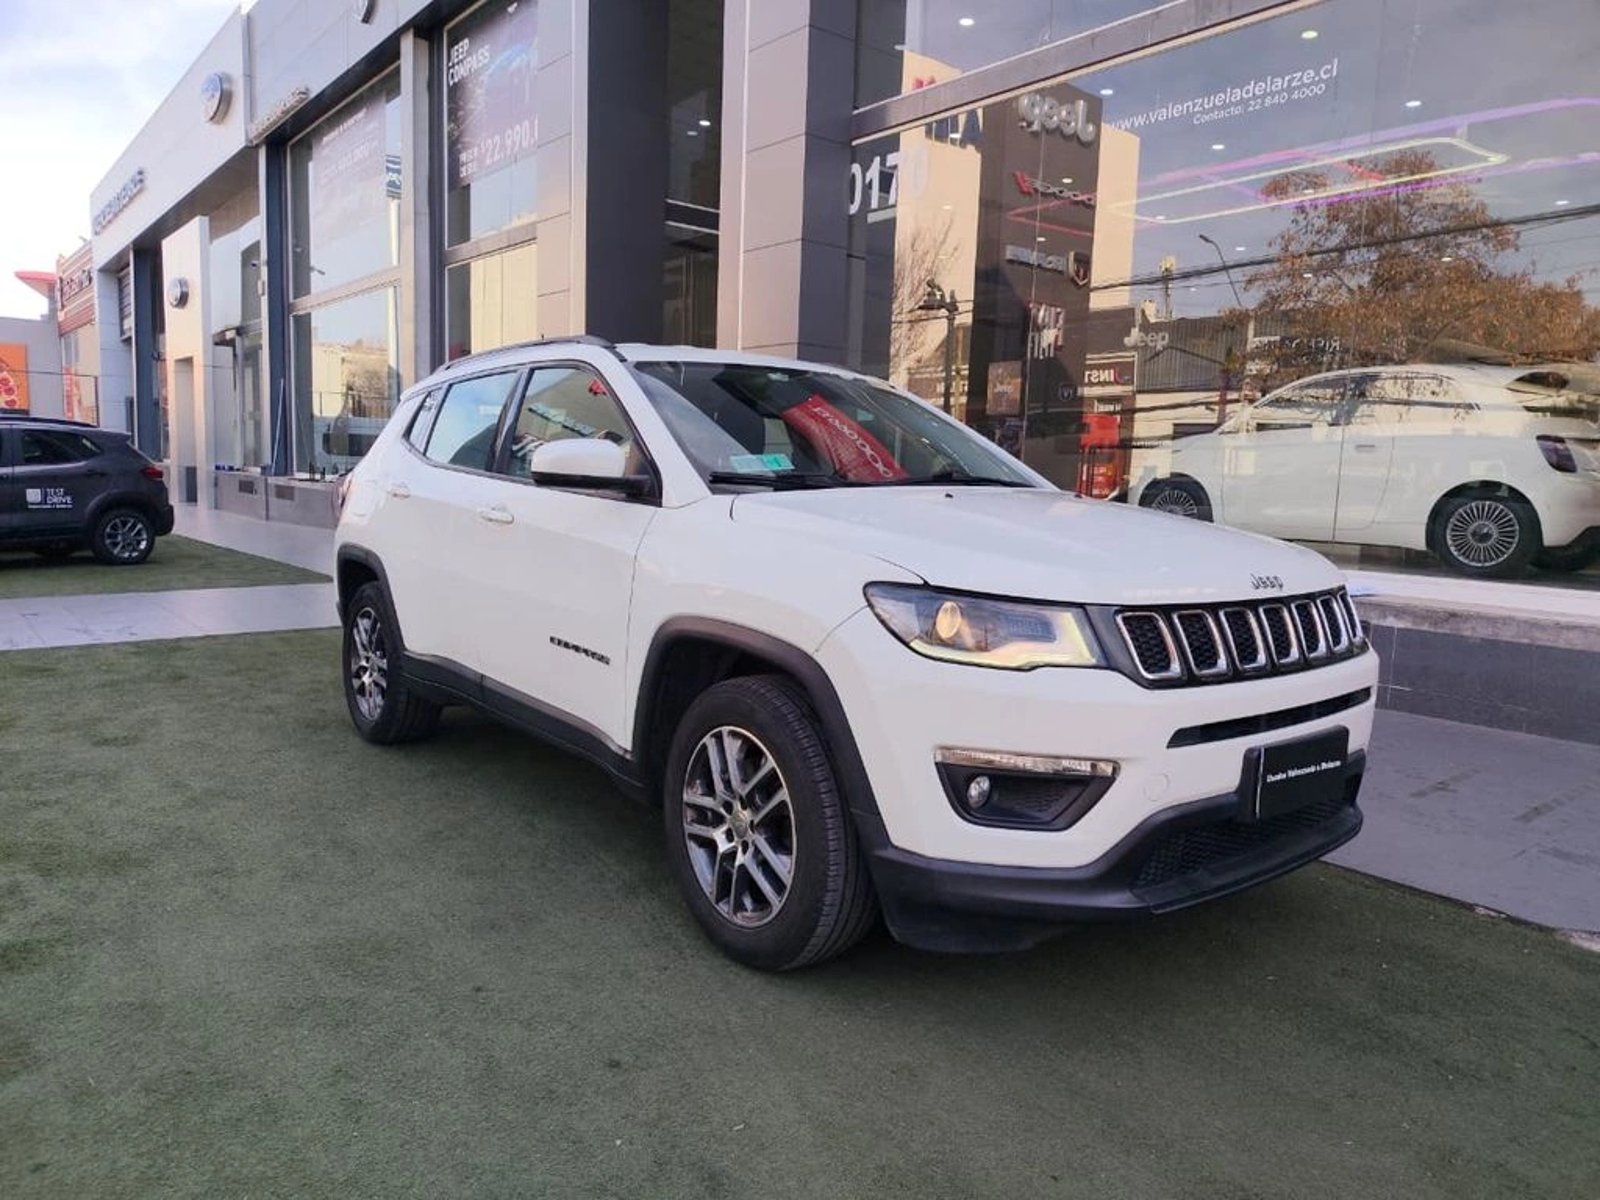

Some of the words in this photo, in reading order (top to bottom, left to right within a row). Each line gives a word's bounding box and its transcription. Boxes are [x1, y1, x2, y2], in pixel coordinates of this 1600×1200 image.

[448, 37, 470, 68] JEEP
[448, 45, 490, 87] COMPASS
[1111, 58, 1338, 131] www.valenzueladelarze.cl
[1247, 100, 1263, 112] 22
[1264, 92, 1289, 106] 840
[1291, 83, 1326, 100] 4000
[1124, 327, 1169, 350] Jeep
[46, 495, 72, 504] DRIVE
[1250, 573, 1283, 591] Jeep
